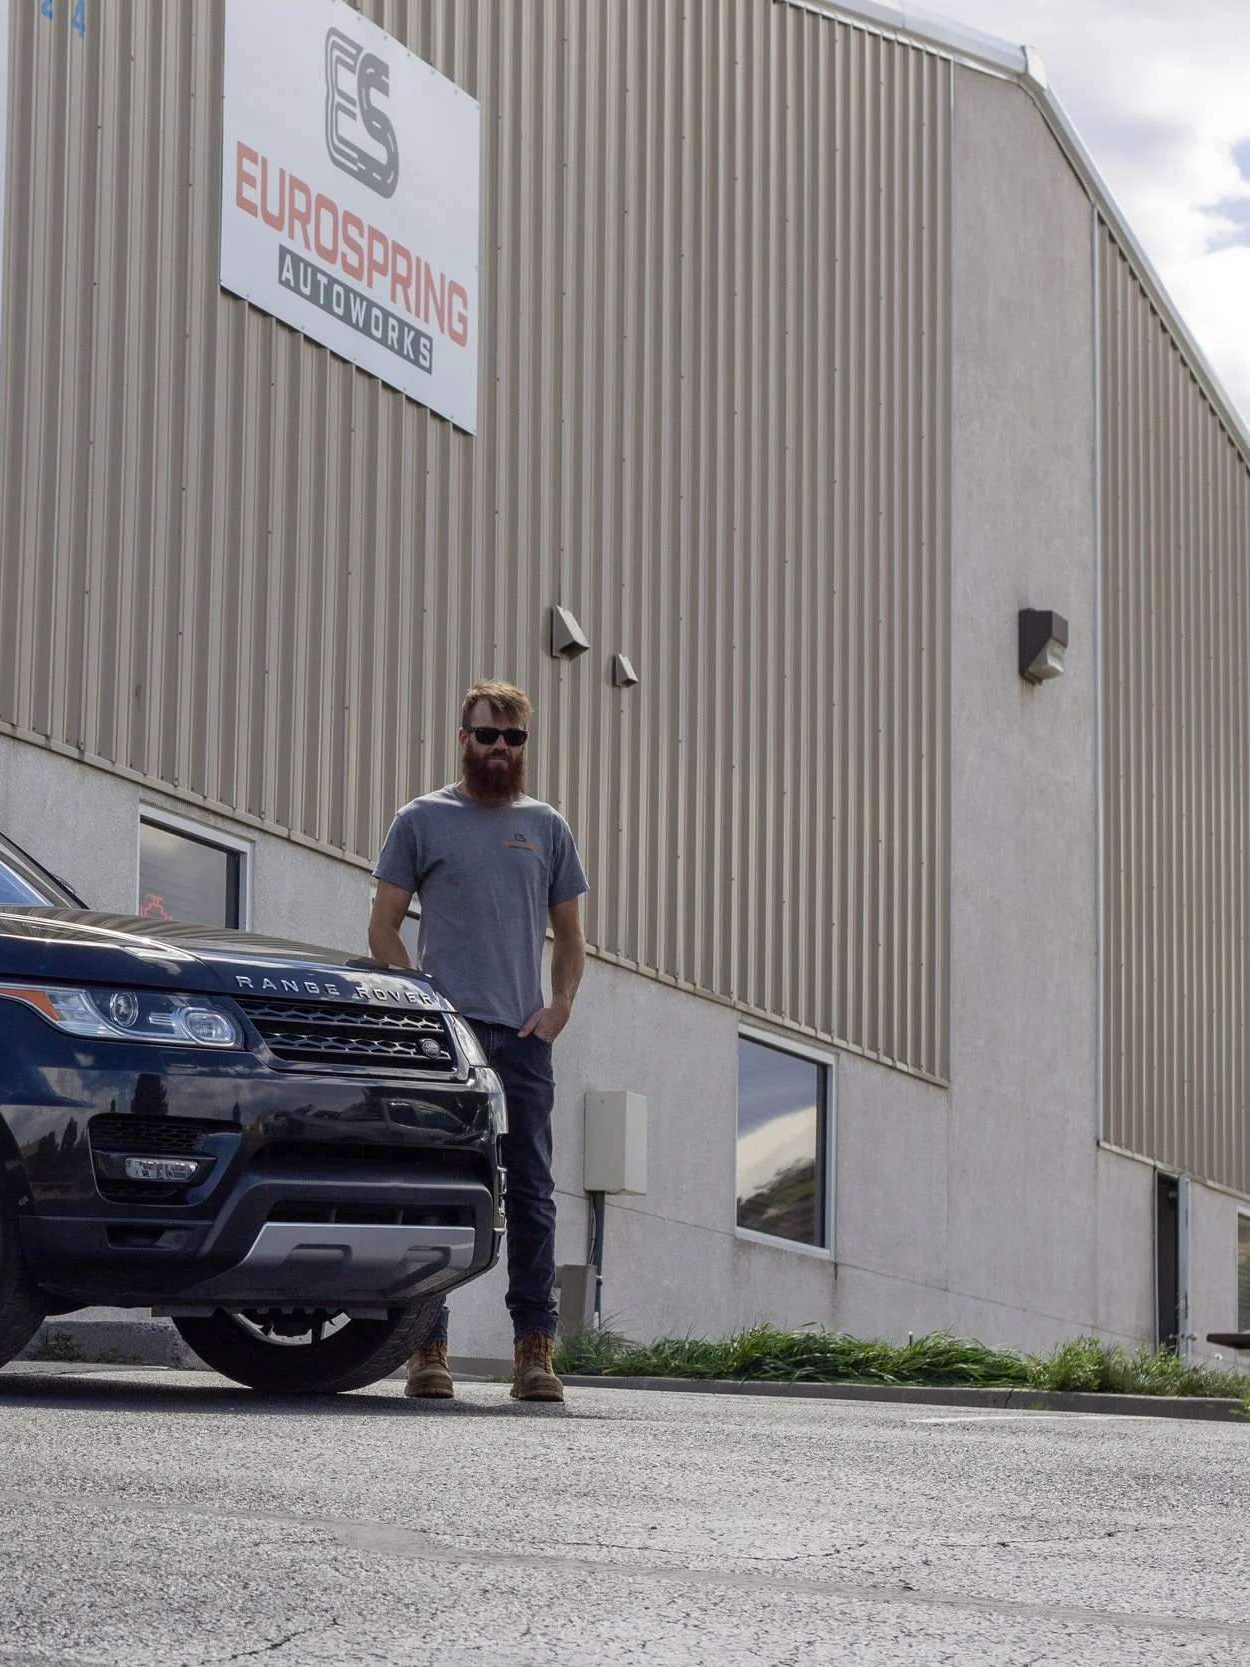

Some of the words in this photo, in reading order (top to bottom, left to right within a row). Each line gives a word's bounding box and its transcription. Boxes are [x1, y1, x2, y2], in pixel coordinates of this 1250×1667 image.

[236, 141, 467, 348] EUROSPRING
[282, 253, 431, 370] AUTOWORKS
[235, 975, 340, 996] RANGE
[355, 986, 434, 1005] ROVER
